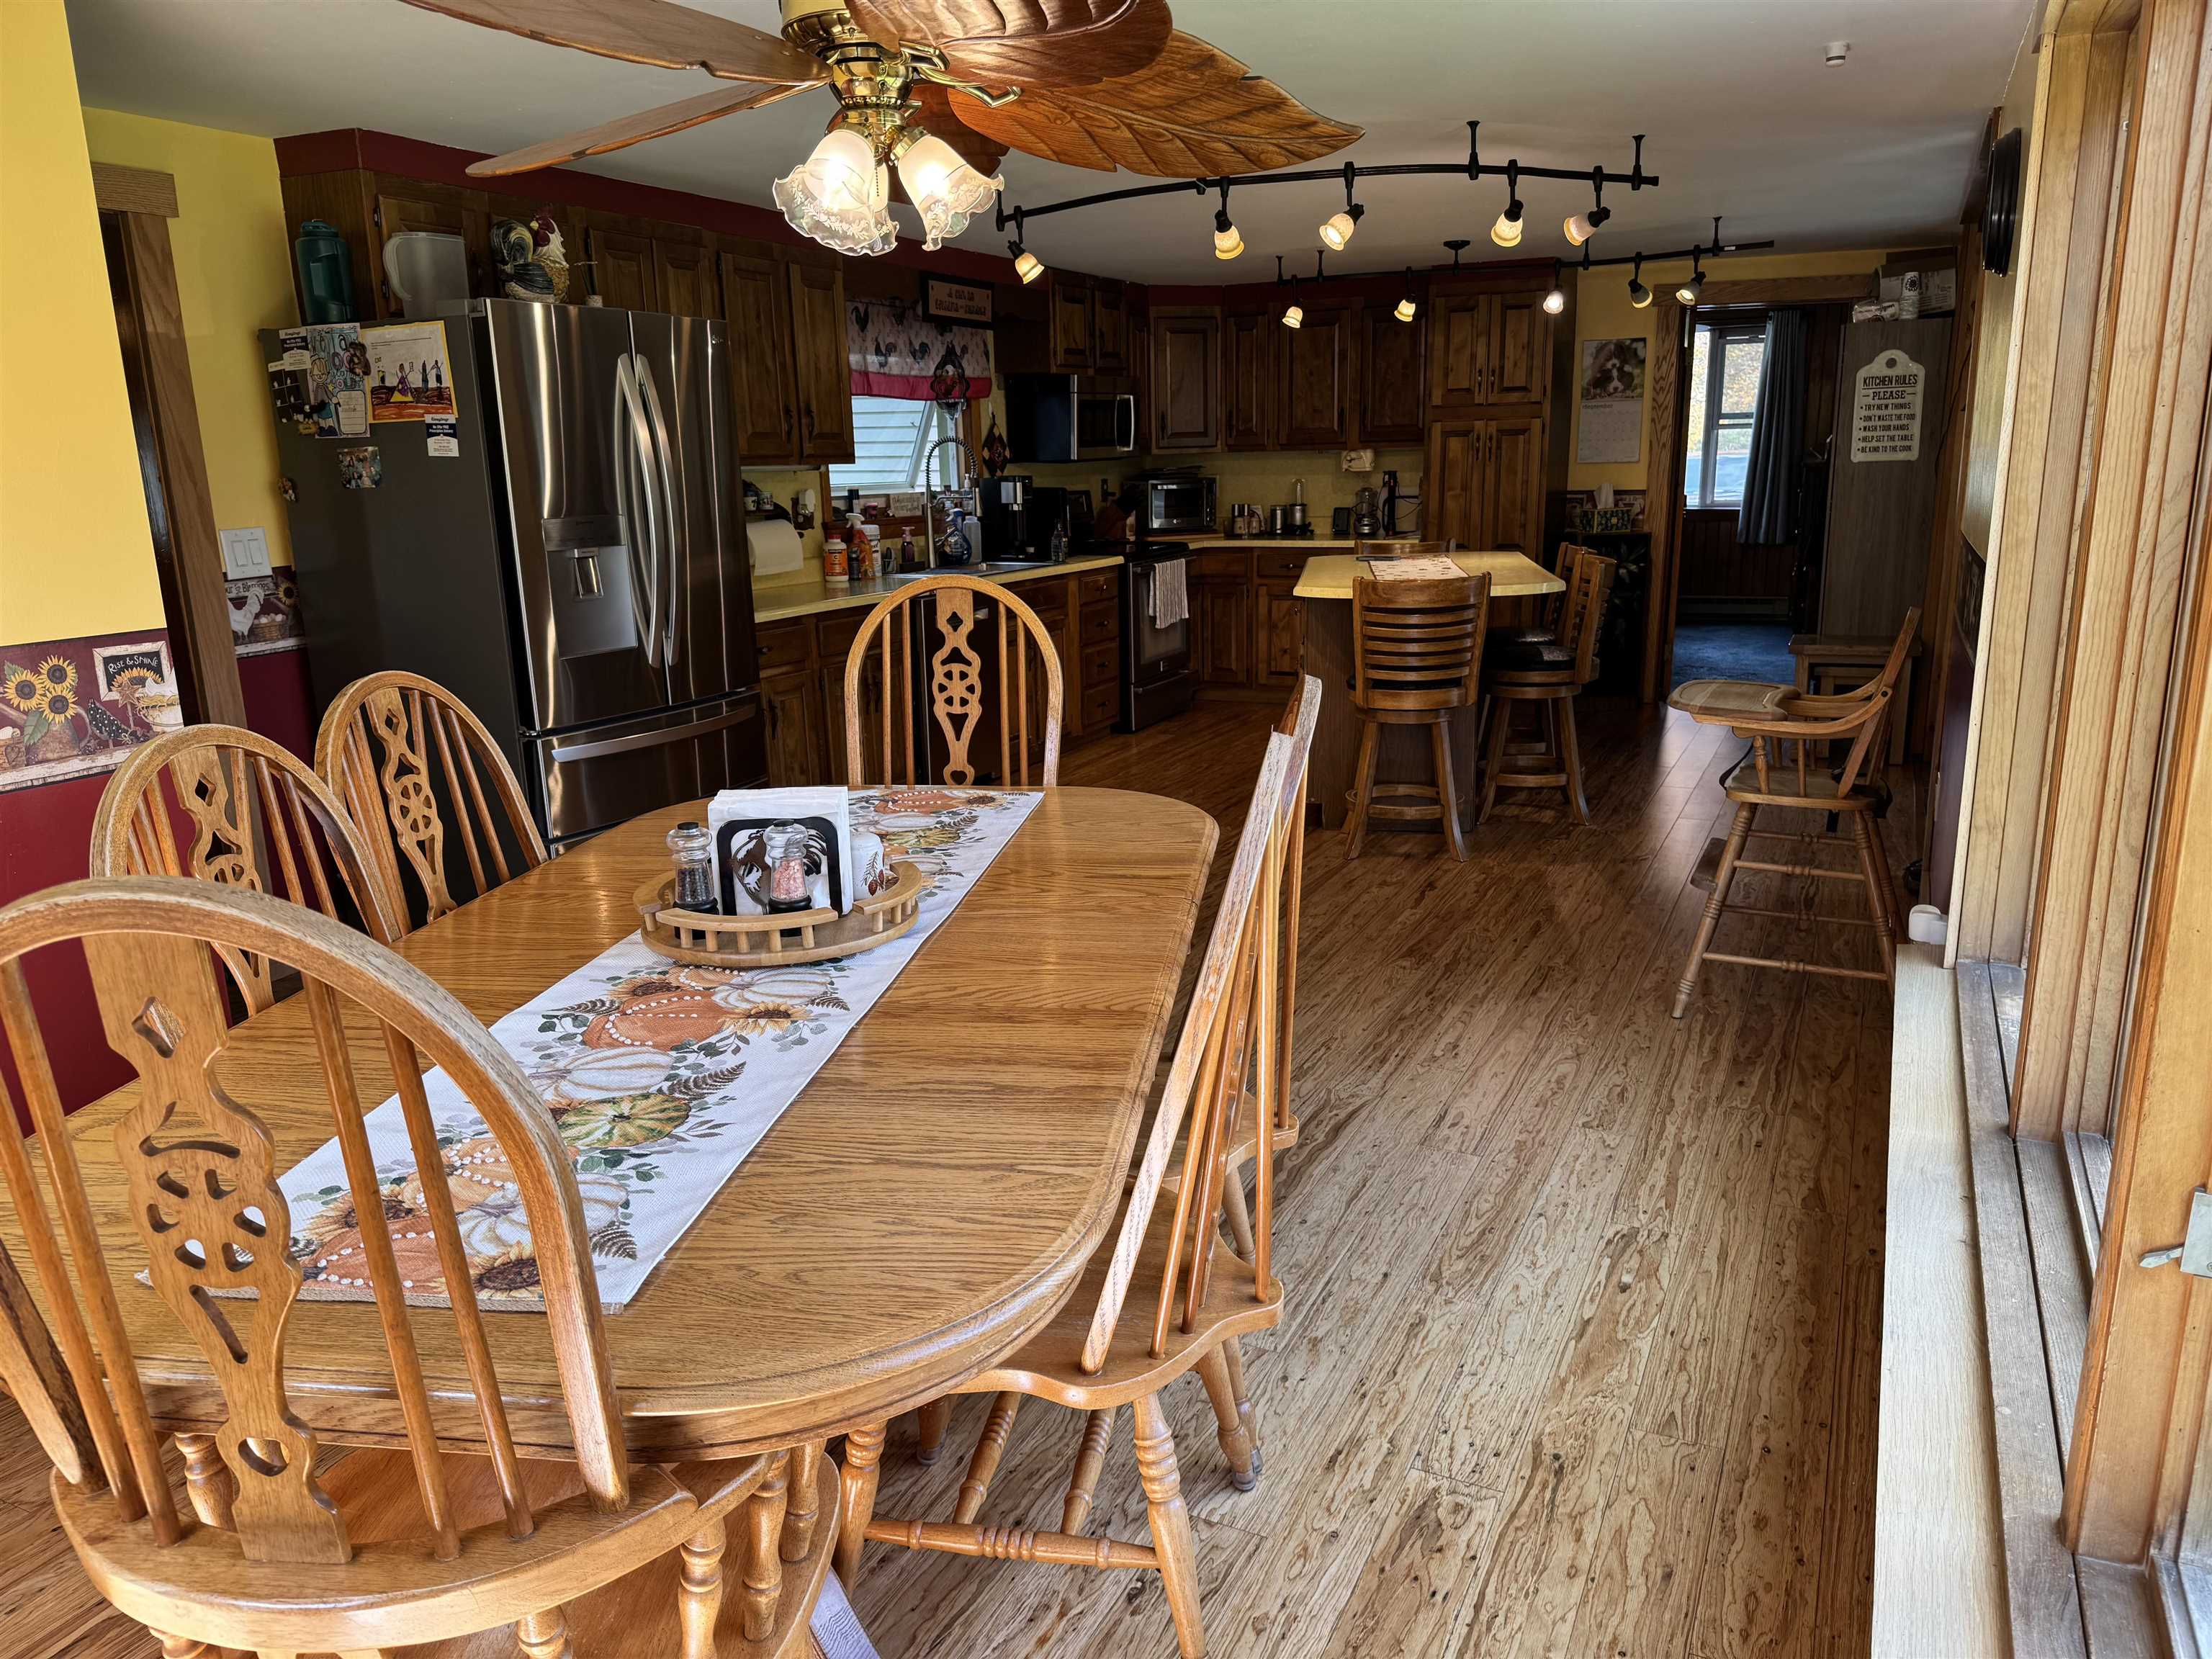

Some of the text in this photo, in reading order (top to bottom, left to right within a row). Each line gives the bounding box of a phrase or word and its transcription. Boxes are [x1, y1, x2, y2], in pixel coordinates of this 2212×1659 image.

[1863, 374, 1917, 387] KITCHEN RULES
[1872, 390, 1906, 400] PLEASE
